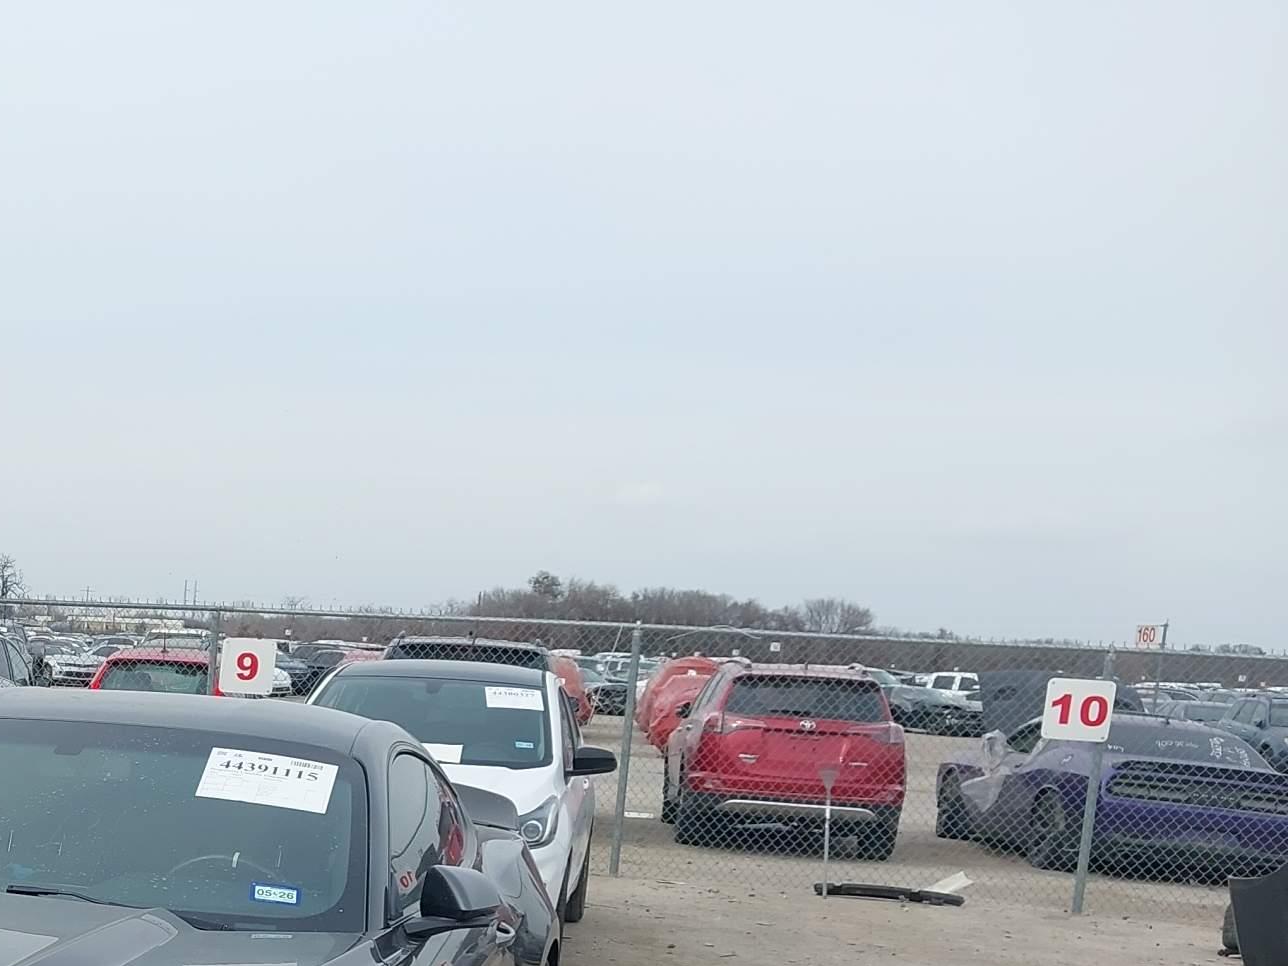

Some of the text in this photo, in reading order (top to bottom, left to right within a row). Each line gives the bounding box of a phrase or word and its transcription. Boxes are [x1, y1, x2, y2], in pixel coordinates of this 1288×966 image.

[1137, 627, 1156, 643] 160
[236, 652, 259, 681] 9
[1051, 693, 1109, 727] 10
[219, 759, 319, 782] 44391115
